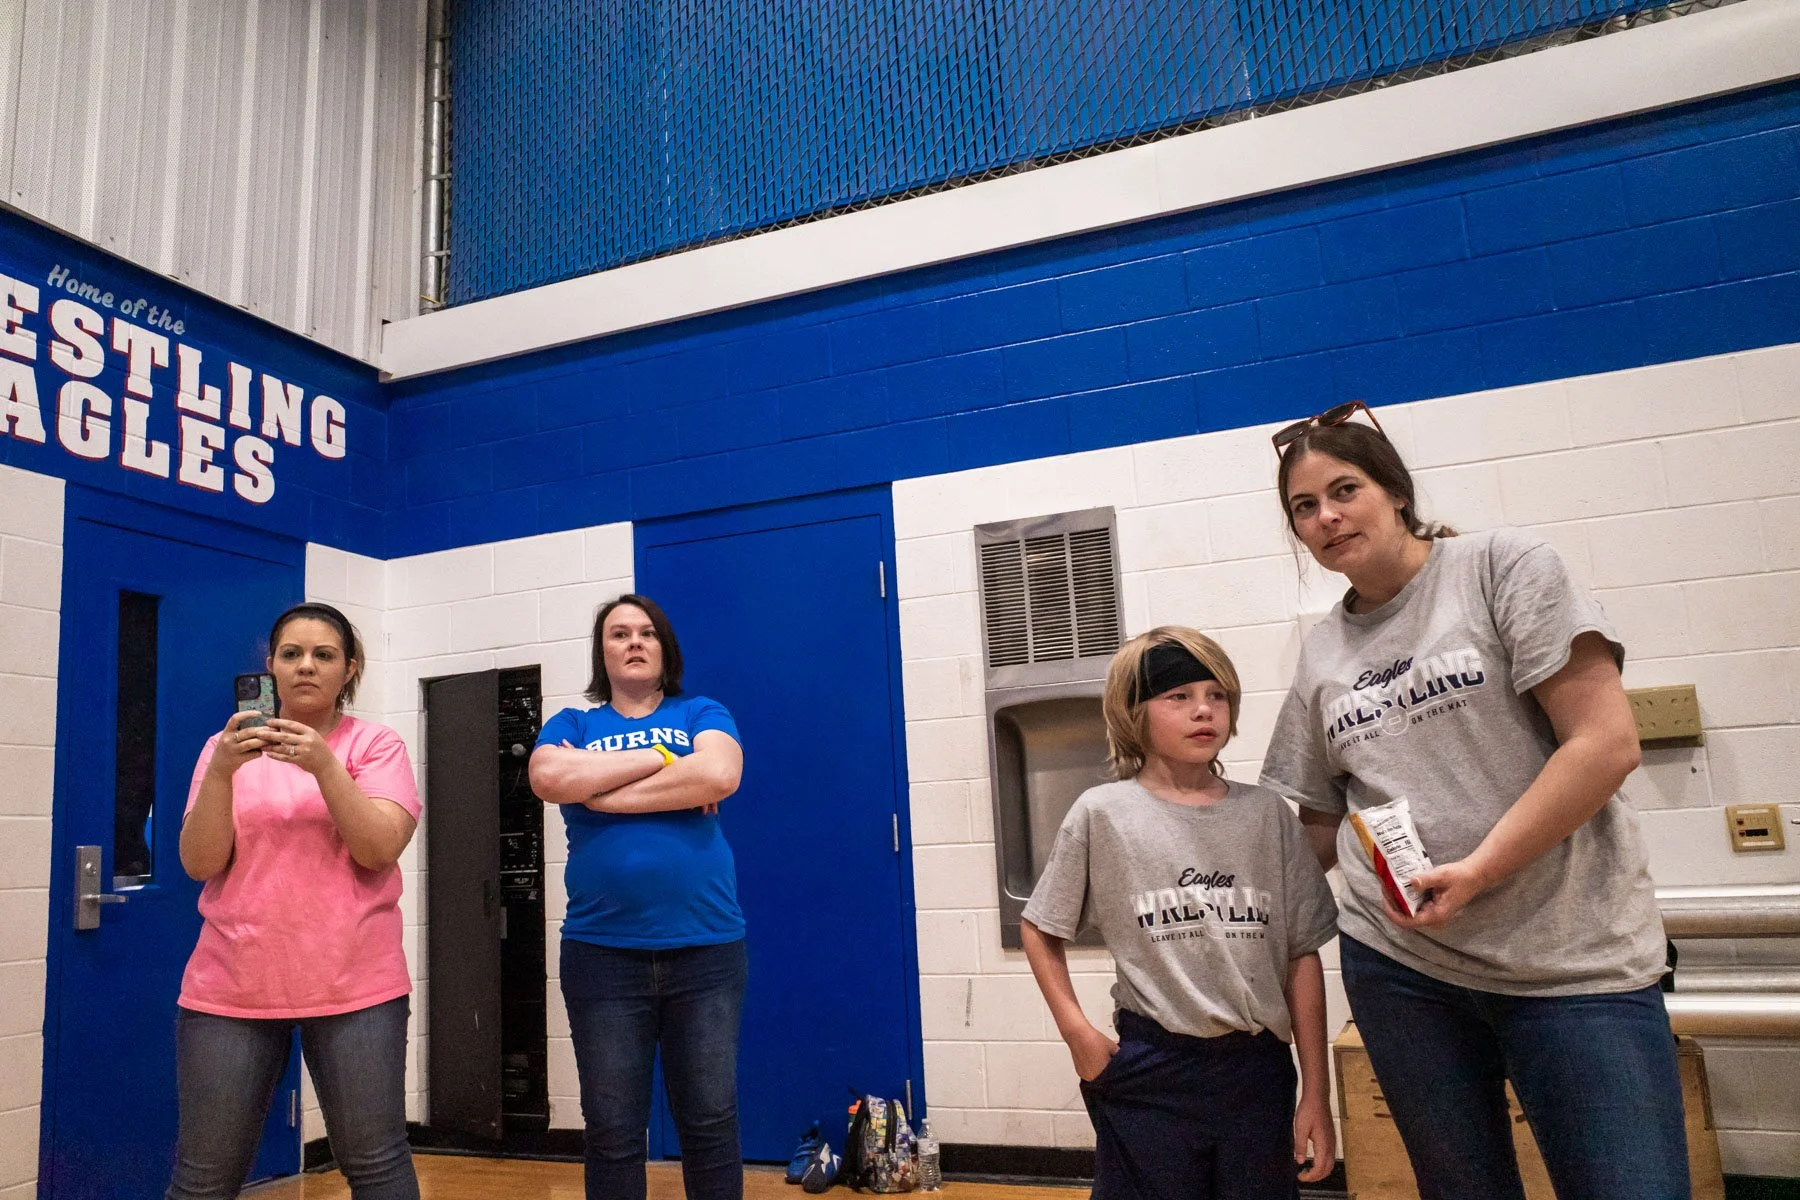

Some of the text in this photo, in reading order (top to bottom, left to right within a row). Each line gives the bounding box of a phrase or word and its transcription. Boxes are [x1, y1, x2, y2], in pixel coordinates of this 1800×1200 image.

[47, 264, 186, 335] Home of the
[0, 272, 346, 460] ESTLING
[0, 356, 276, 504] AGLES
[1353, 656, 1414, 691] Eagles
[585, 727, 690, 752] BURNS
[1352, 735, 1361, 744] IT
[1364, 731, 1380, 741] ALL
[1411, 715, 1423, 725] ON
[1427, 706, 1445, 718] THE
[1449, 699, 1468, 711] MAT
[1178, 867, 1236, 891] Eagles
[1151, 933, 1175, 943] LEAVE
[1178, 932, 1186, 940] IT
[1189, 930, 1204, 938] ALL
